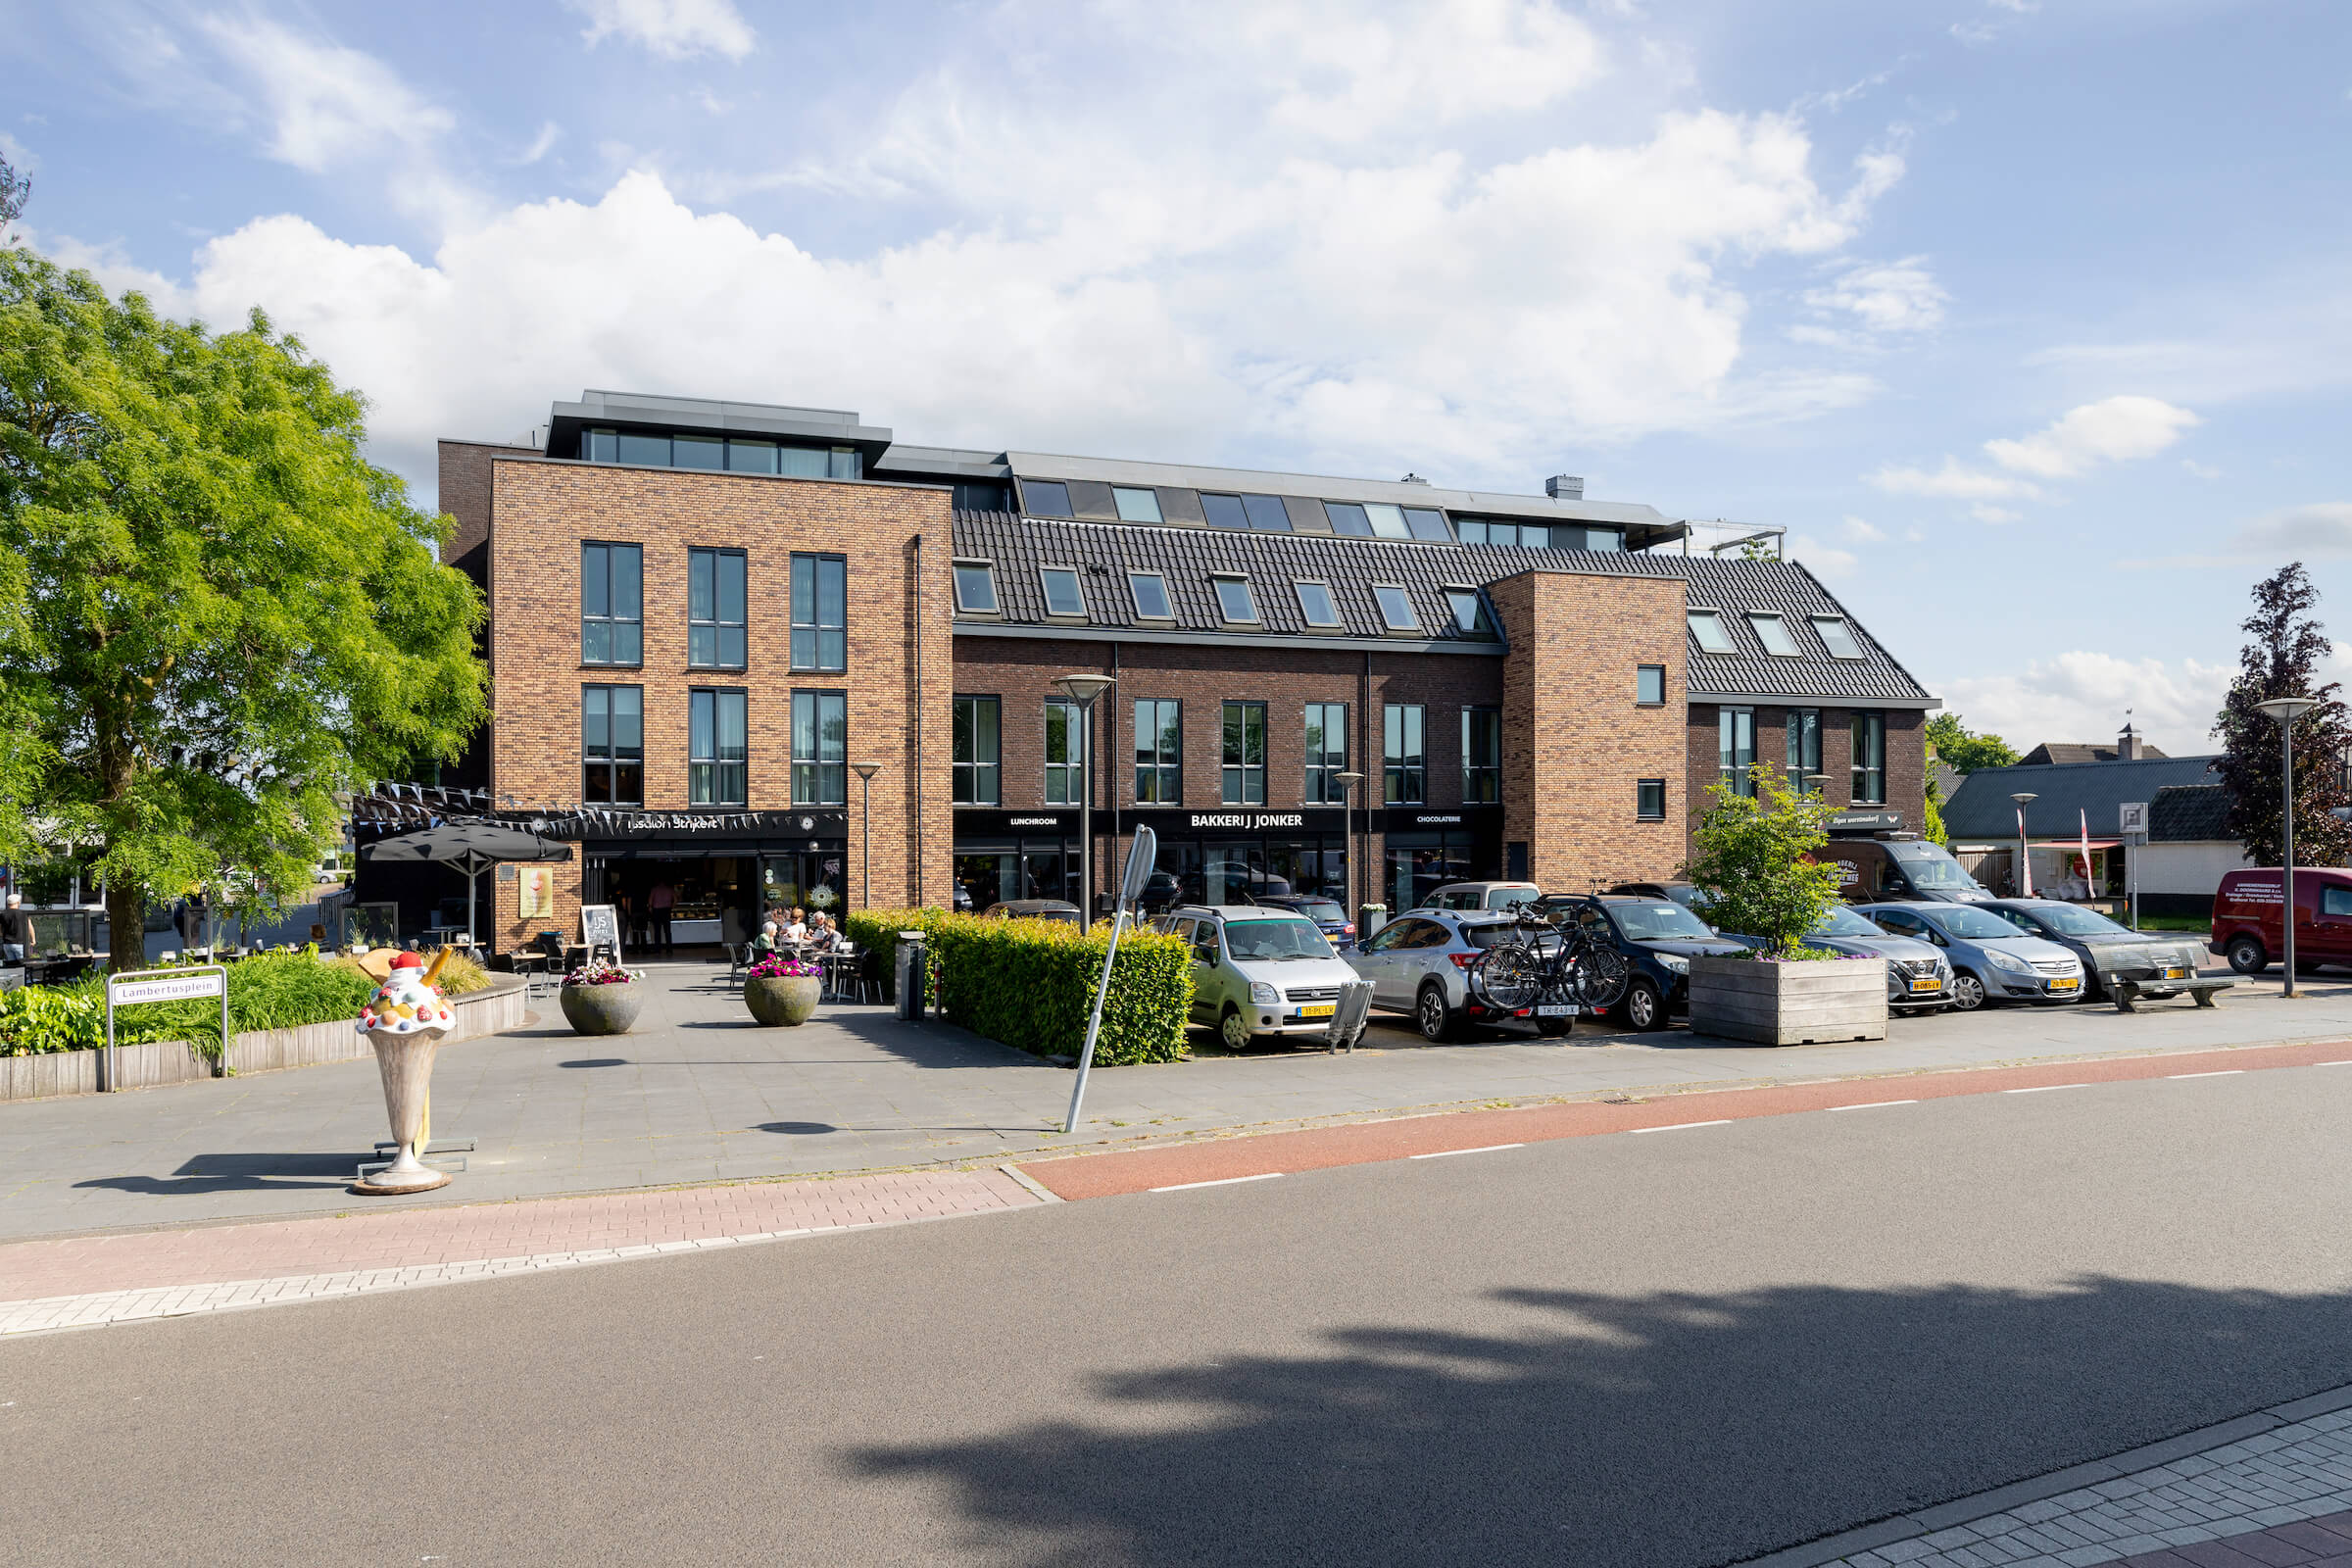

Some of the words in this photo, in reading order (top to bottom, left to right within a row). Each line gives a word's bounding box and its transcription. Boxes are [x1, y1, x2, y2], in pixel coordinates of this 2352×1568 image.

[1191, 814, 1250, 829] BAKKERIJ
[1254, 814, 1302, 829] JONKER
[122, 982, 213, 998] Lambertusplein
